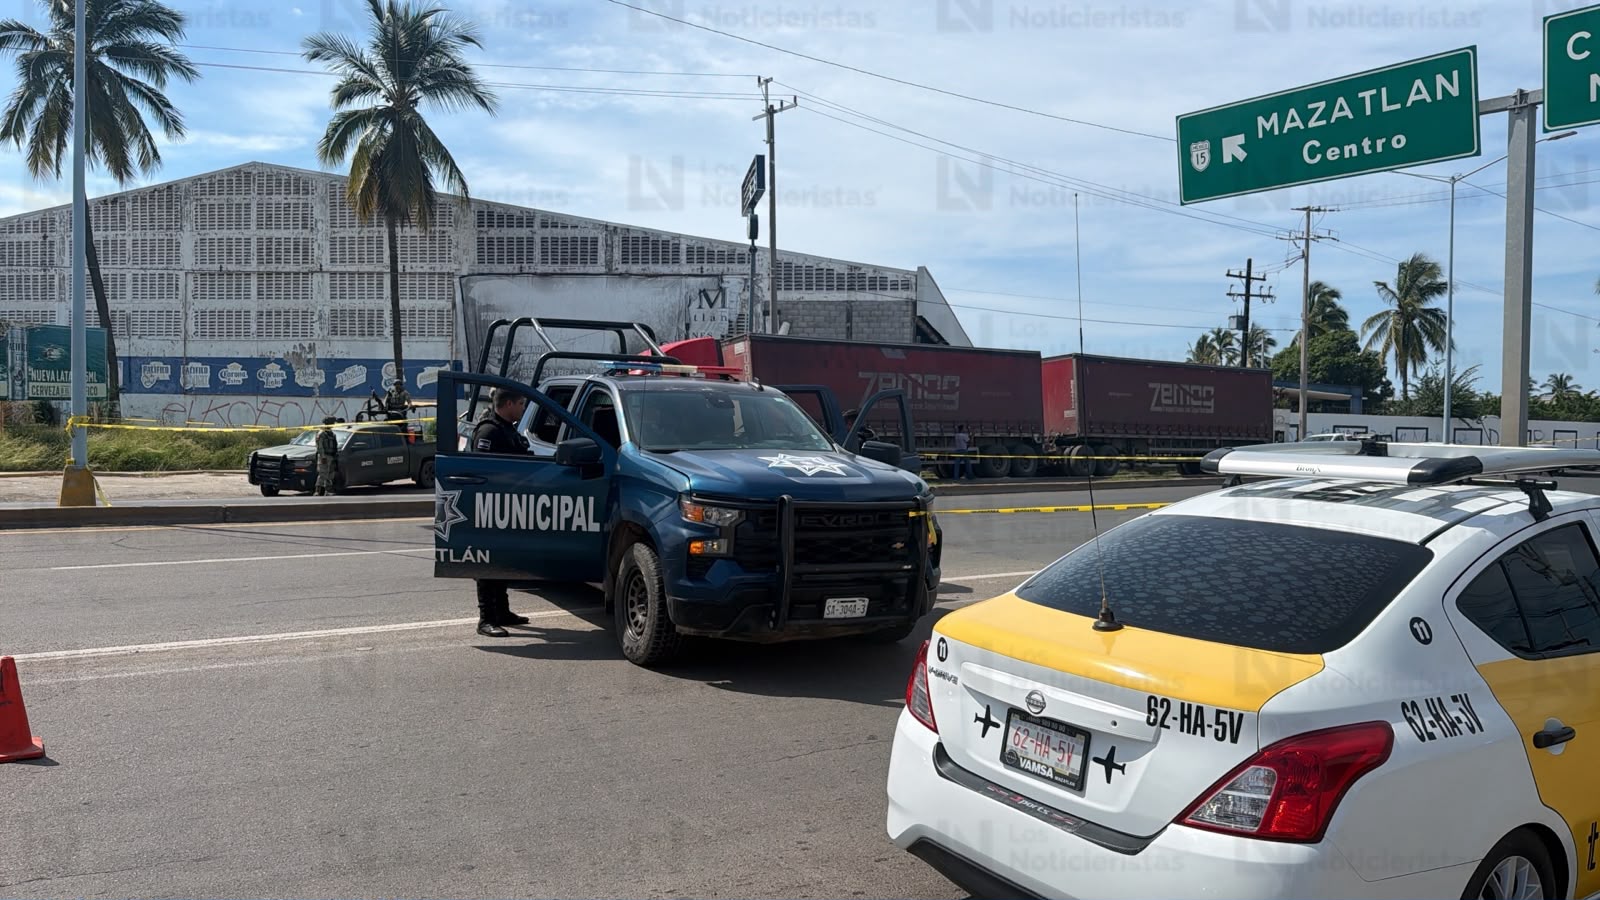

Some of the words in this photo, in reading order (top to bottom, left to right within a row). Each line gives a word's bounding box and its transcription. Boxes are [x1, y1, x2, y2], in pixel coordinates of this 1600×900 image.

[1256, 69, 1460, 139] MAZATLAN
[1195, 152, 1207, 166] 15
[1302, 133, 1407, 165] Centro
[31, 368, 55, 382] NUEVA
[31, 385, 60, 396] CERVEZA
[474, 491, 601, 532] MUNICIPAL
[435, 545, 491, 564] TLÁN
[1412, 620, 1431, 641] 11
[1145, 694, 1244, 745] 62-HA-5V
[1400, 692, 1485, 743] 62-HA-5V
[1012, 725, 1076, 768] 62-HA-5V
[1018, 755, 1055, 780] VAMSA
